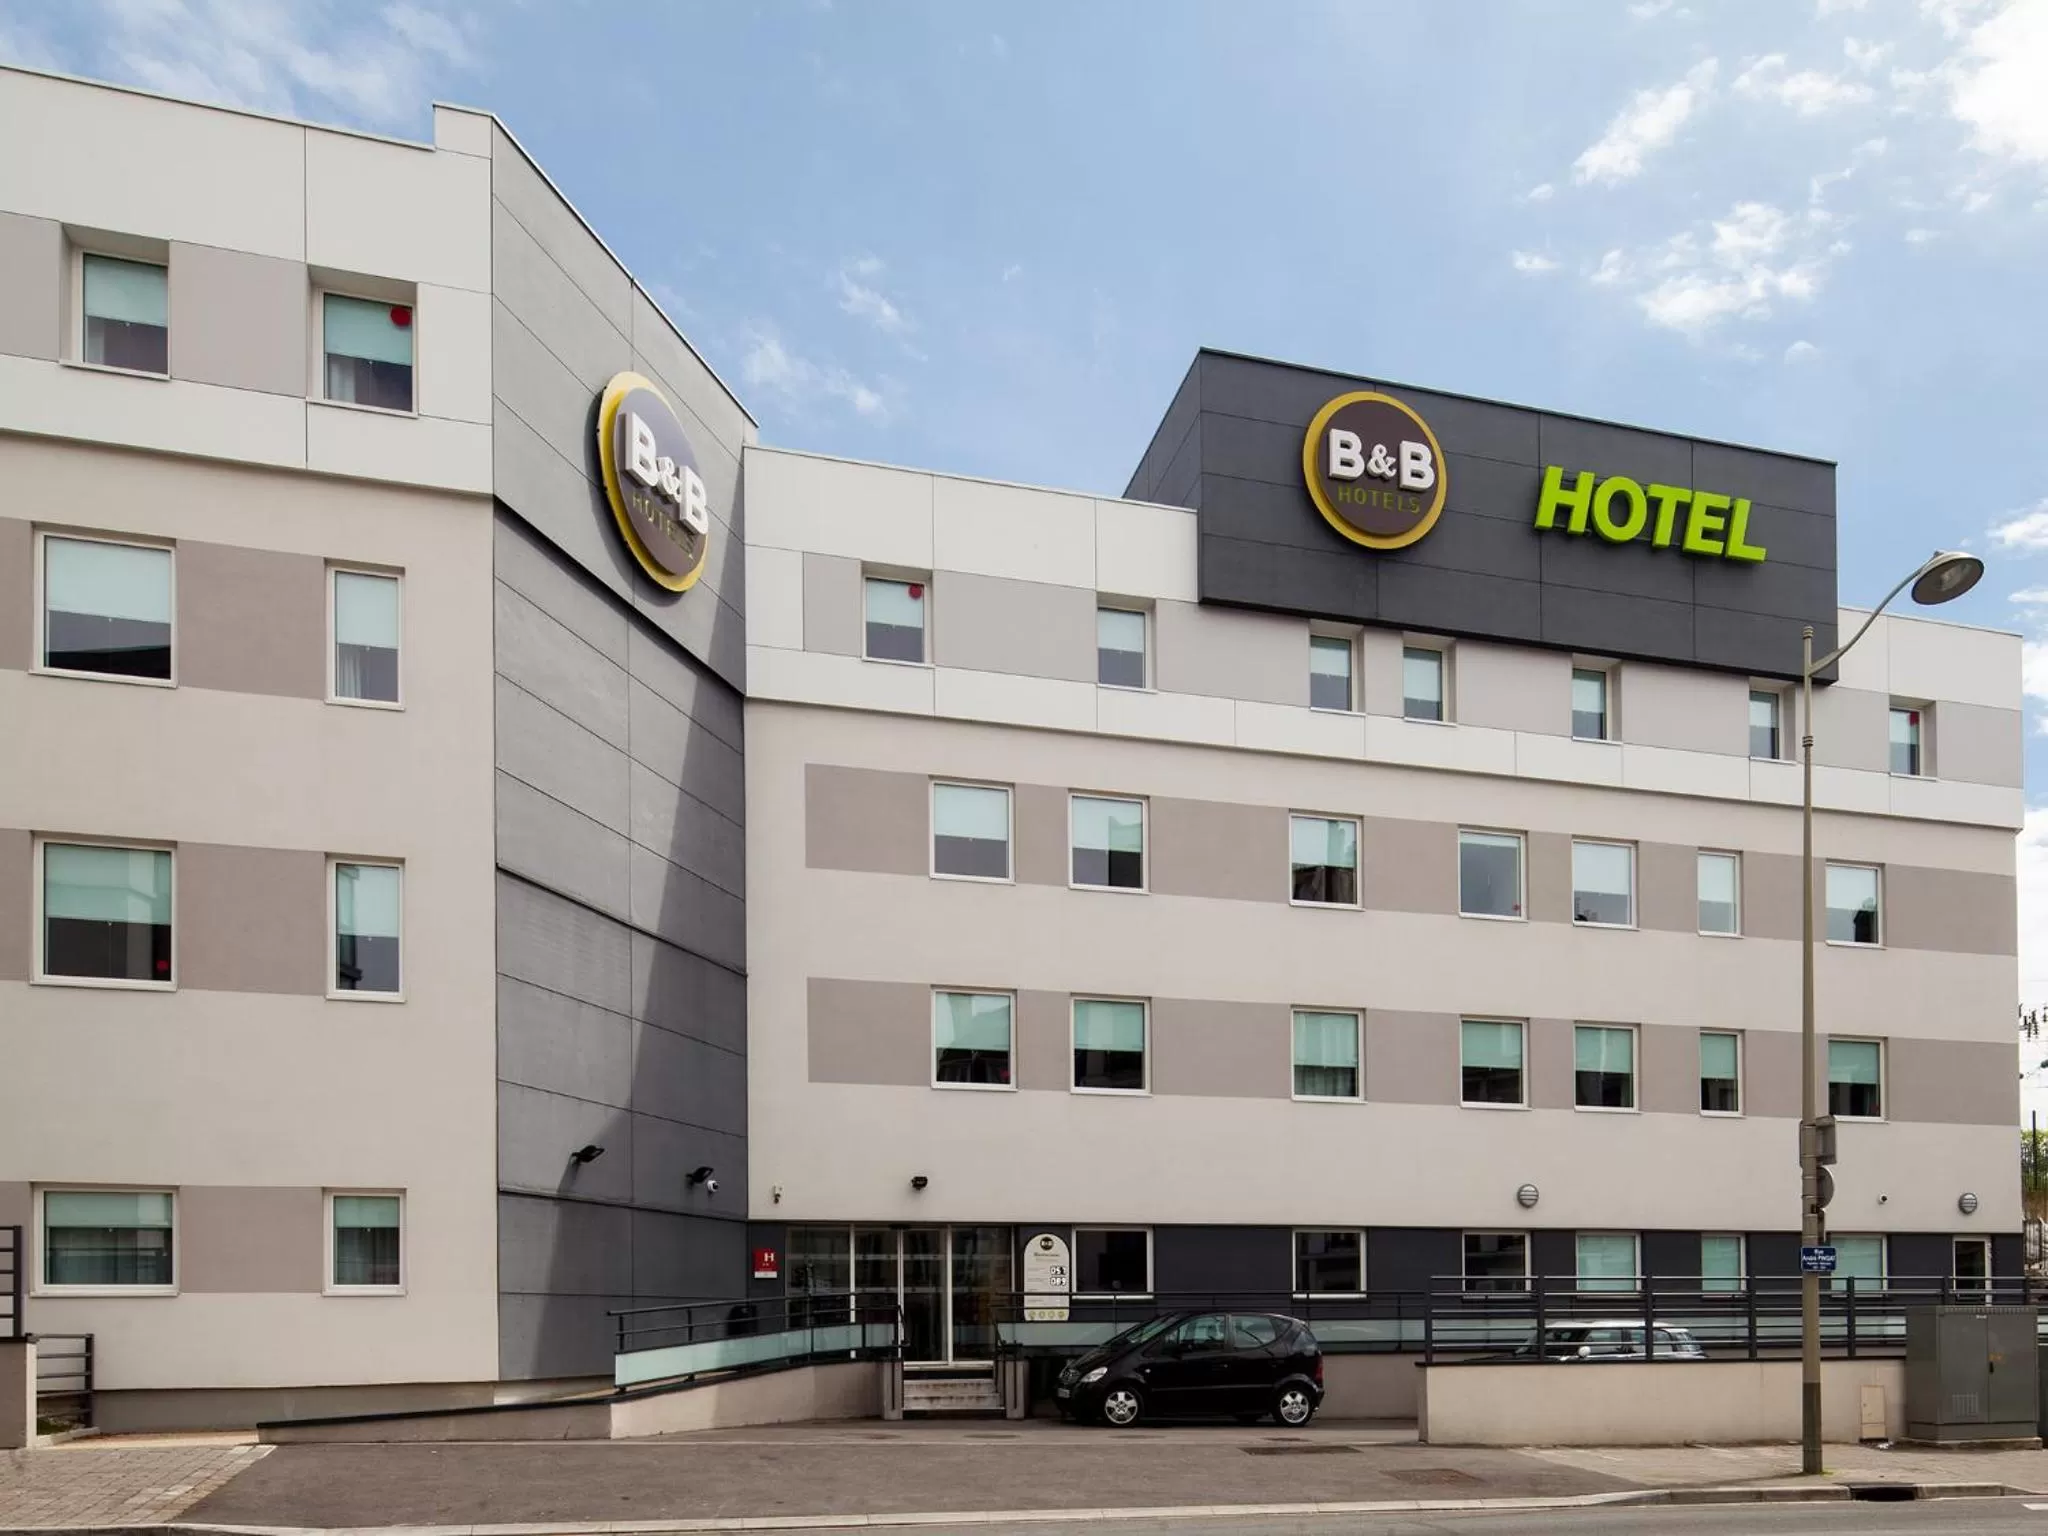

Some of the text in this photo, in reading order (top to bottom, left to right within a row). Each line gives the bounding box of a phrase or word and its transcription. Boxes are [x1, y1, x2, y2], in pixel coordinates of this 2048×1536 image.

[625, 412, 709, 535] B&B
[1329, 428, 1435, 493] B&B
[1337, 486, 1420, 515] HOTELS
[1534, 465, 1767, 565] HOTEL
[764, 1252, 774, 1262] H
